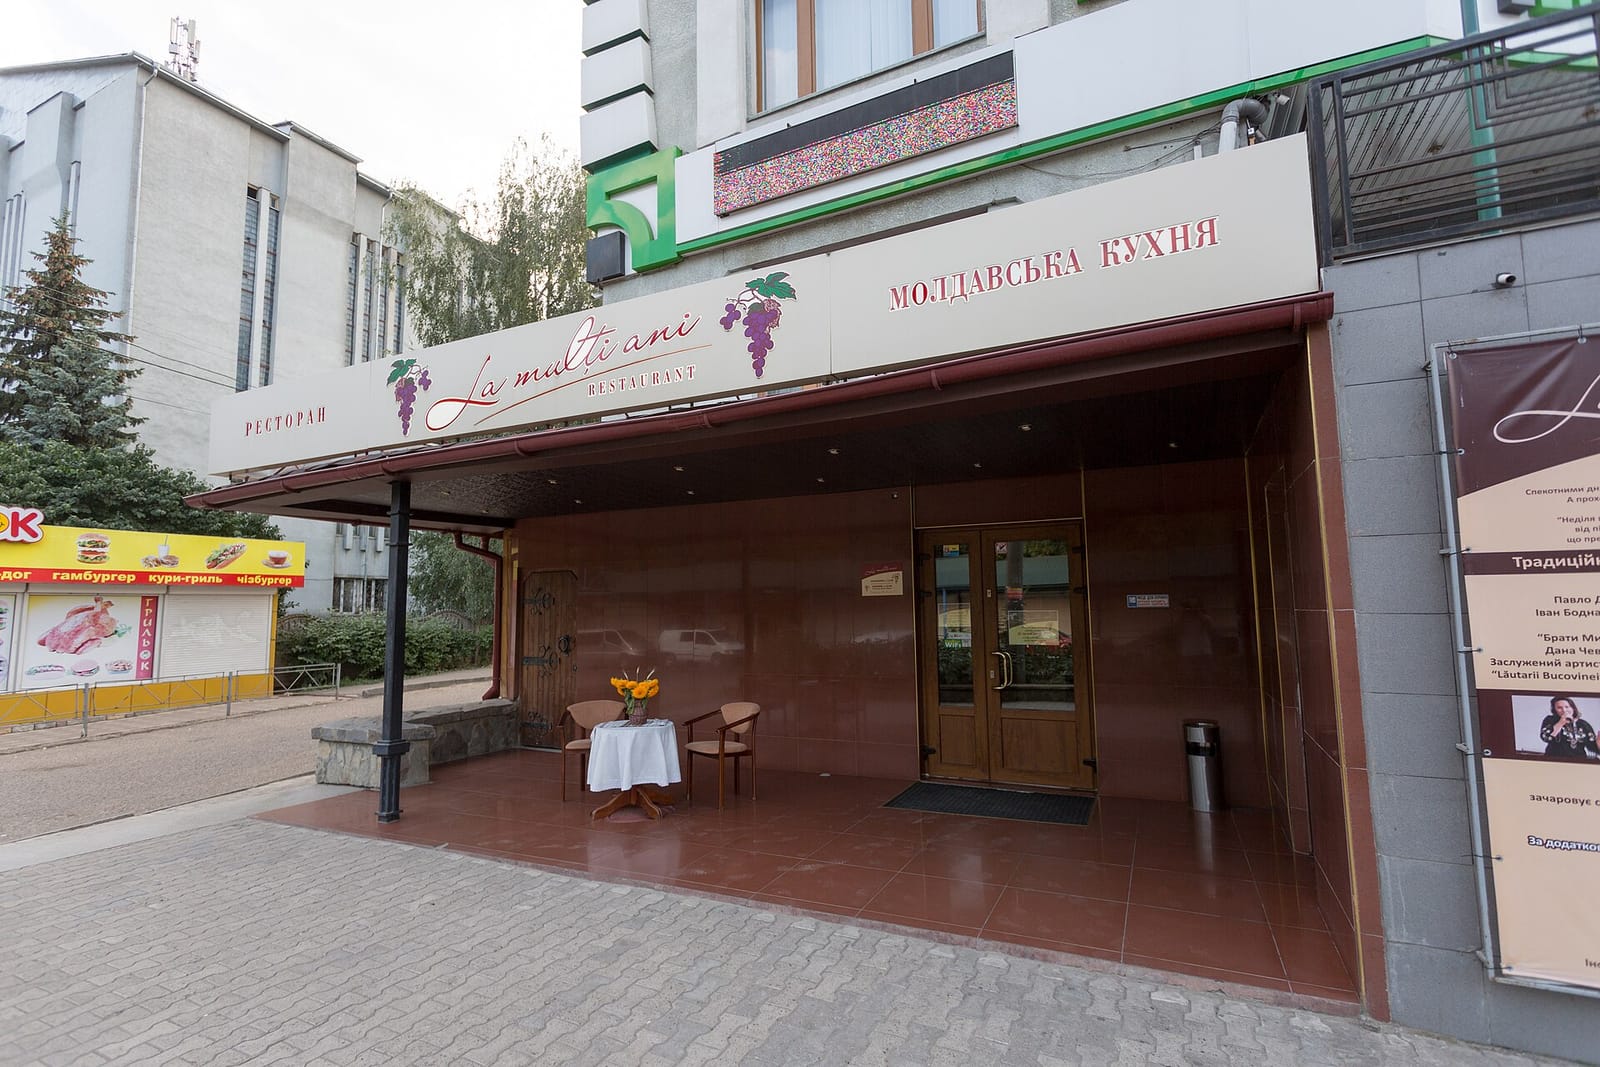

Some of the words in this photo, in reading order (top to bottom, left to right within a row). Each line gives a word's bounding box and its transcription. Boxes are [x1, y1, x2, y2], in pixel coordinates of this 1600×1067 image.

[889, 248, 1084, 312] МОЛДАВСЬКА
[1099, 216, 1220, 268] КУХНЯ
[424, 354, 508, 431] La
[622, 312, 702, 354] ani
[588, 365, 697, 397] RESTAURANT
[245, 406, 327, 436] РЕСТОРАН
[1525, 486, 1584, 496] Спекотними
[1576, 496, 1600, 504] прох
[1575, 526, 1590, 534] від
[0, 570, 33, 581] дог
[52, 571, 136, 585] гамбургер
[148, 573, 223, 585] кури-гриль
[236, 575, 293, 586] чізбургер
[1554, 596, 1591, 605] Павло
[1535, 608, 1560, 617] Іван
[1544, 646, 1576, 656] Дана
[1490, 657, 1562, 669] Заслужений
[1565, 659, 1600, 669] артис
[1529, 794, 1592, 807] зачаровує
[1527, 835, 1544, 846] За
